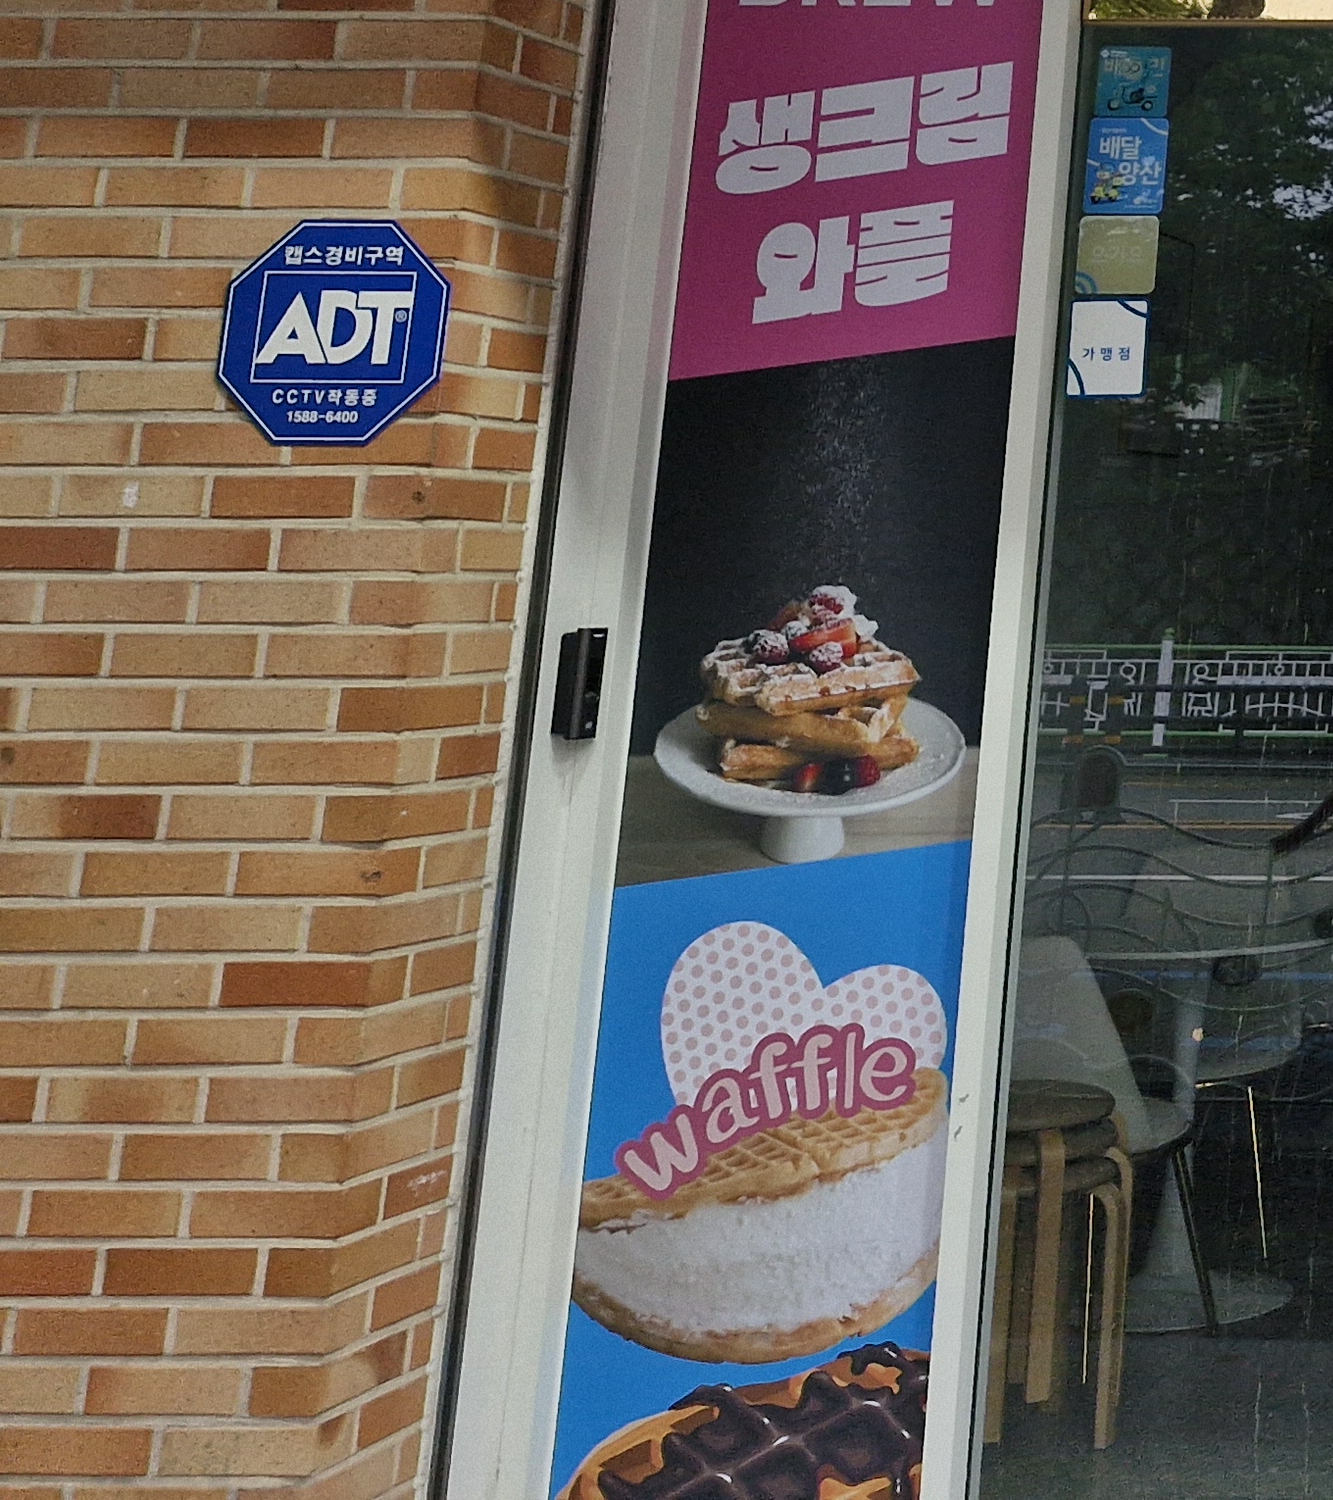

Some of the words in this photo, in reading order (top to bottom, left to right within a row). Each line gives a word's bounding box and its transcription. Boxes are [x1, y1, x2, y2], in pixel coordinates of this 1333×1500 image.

[715, 62, 1014, 194] 생크림
[1099, 136, 1142, 160] 배달
[1118, 161, 1162, 185] 양산
[285, 246, 404, 265] 캡스경비구역
[752, 200, 954, 324] 와플
[255, 290, 414, 364] ADT
[272, 389, 377, 406] CCTV작동중
[287, 411, 358, 423] 1588-6400
[621, 1029, 912, 1195] waffle
